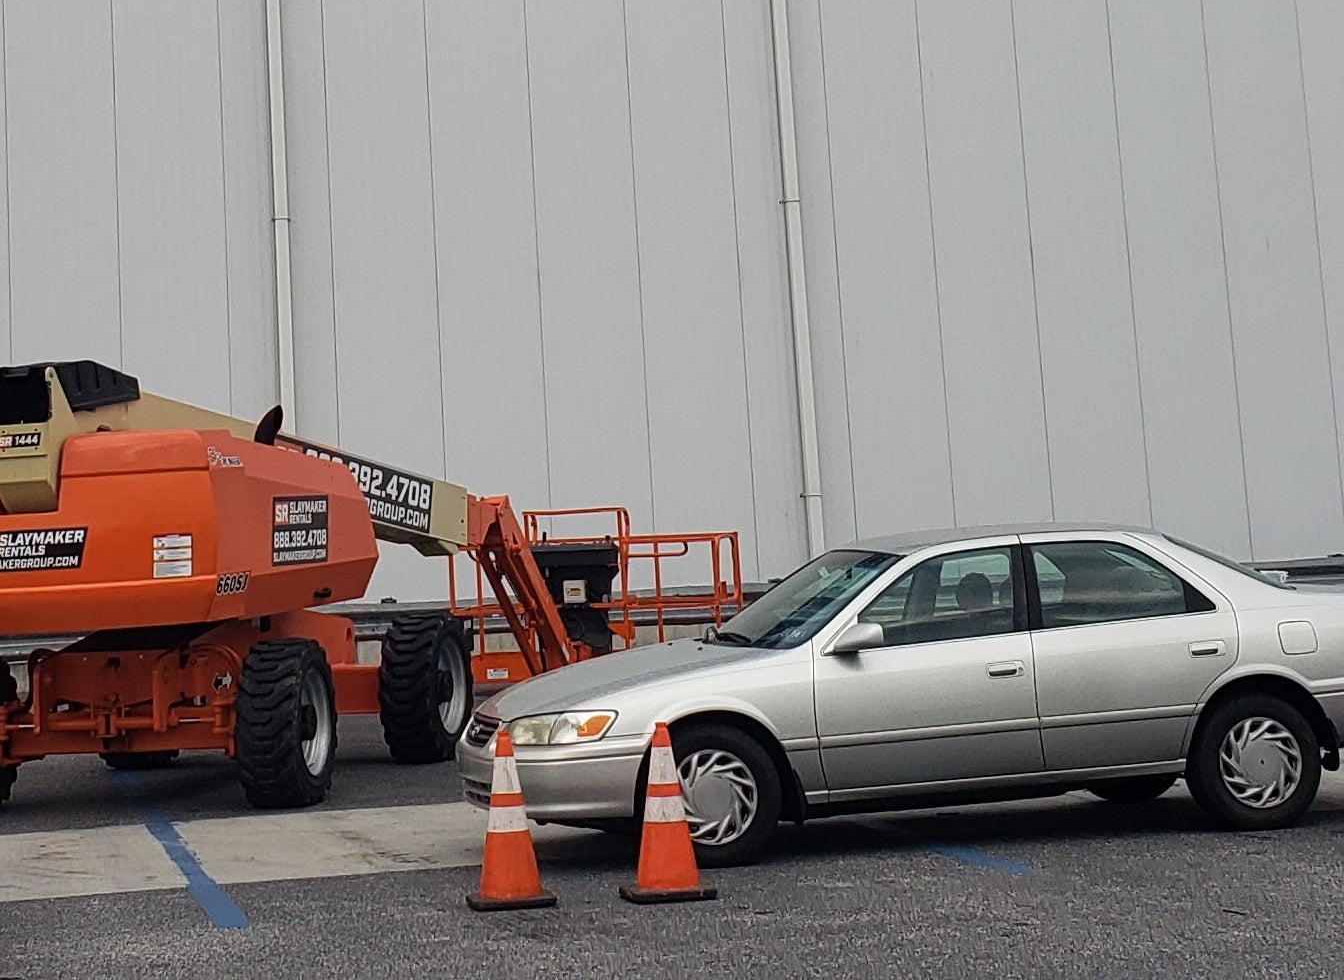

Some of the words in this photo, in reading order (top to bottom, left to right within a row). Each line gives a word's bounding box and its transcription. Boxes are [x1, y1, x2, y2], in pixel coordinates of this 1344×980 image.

[15, 435, 38, 446] 1444
[275, 504, 289, 523] SR
[290, 500, 327, 513] SLAYMAKER
[290, 513, 312, 524] RENTALS
[0, 530, 84, 546] SLAYMAKER
[274, 529, 327, 548] 888.392.4708
